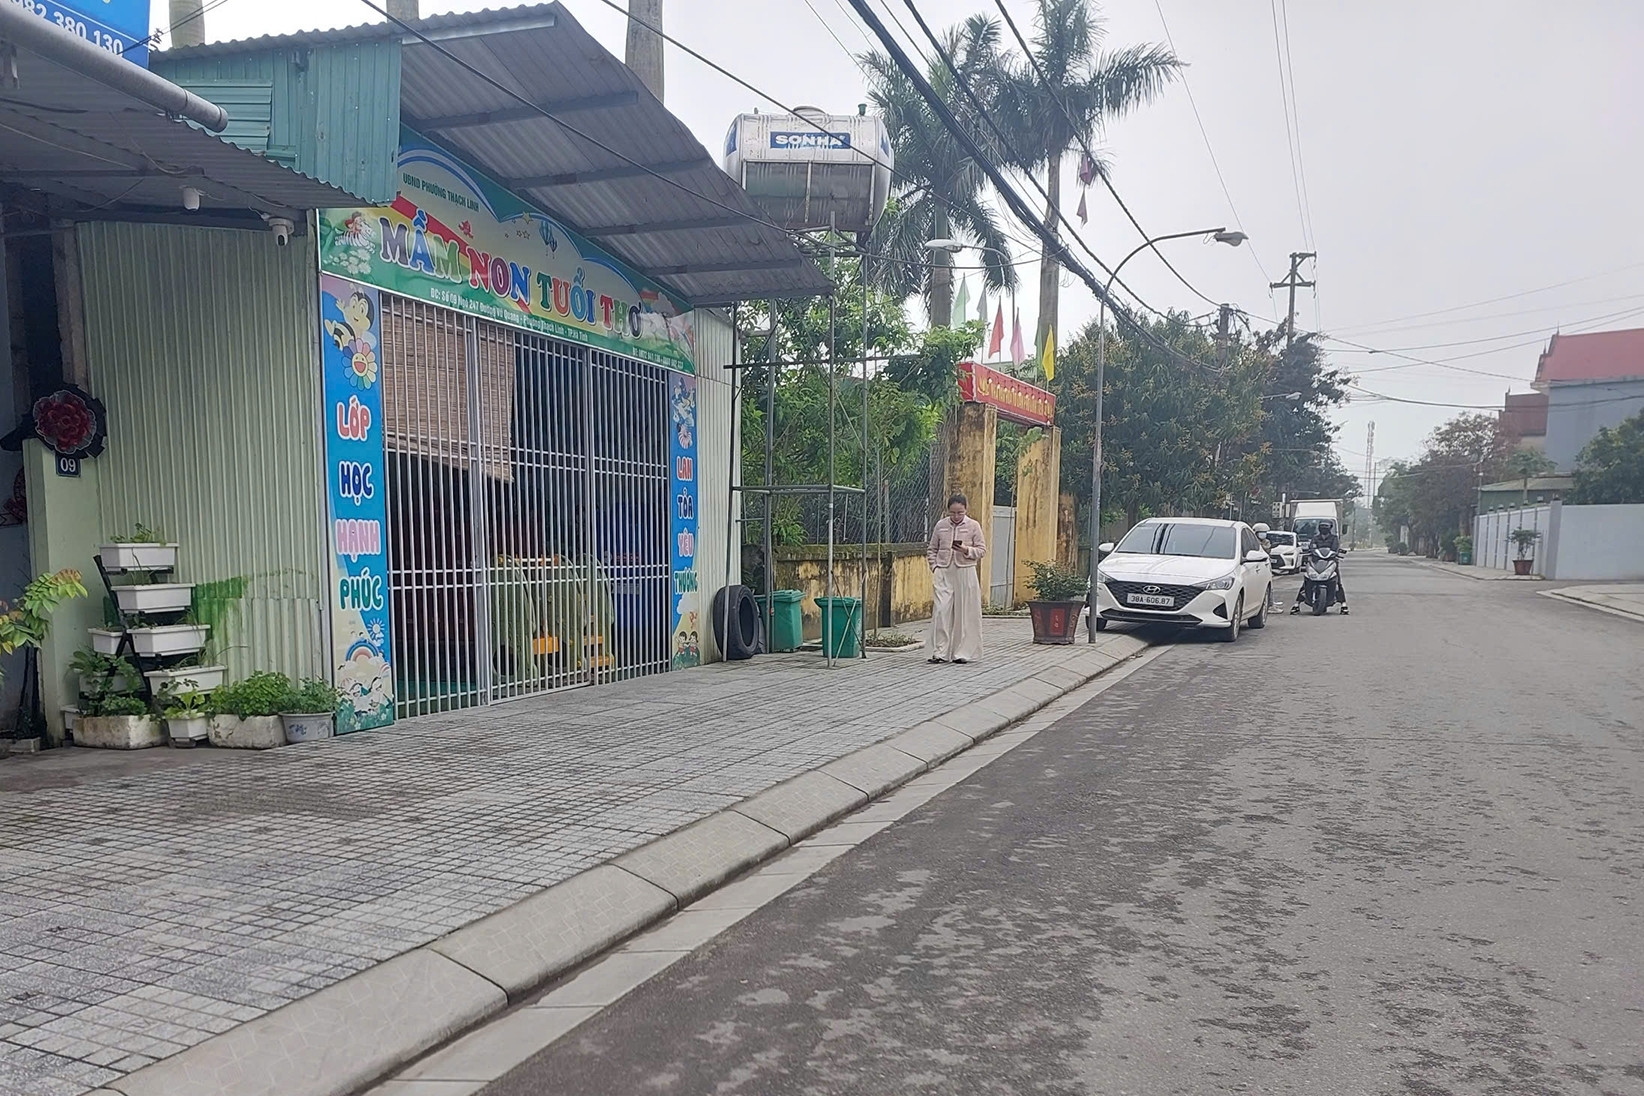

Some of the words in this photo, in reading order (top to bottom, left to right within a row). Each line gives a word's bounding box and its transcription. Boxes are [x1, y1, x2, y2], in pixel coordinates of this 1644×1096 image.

[93, 29, 123, 57] 130
[402, 172, 421, 189] UBND
[421, 180, 447, 199] PHƯỜNG
[447, 190, 467, 206] THẠCH
[466, 199, 479, 212] LINH
[379, 208, 461, 283] MẦM
[466, 246, 531, 305] NON
[536, 266, 596, 326] TUỔI
[600, 294, 642, 340] THƠ
[337, 394, 371, 441] LỚP
[60, 457, 77, 472] 09
[339, 460, 374, 506] HỌC
[676, 456, 693, 481] LAN
[677, 487, 694, 519] TỎA
[335, 518, 381, 562] HẠNH
[677, 527, 694, 557] YÊU
[339, 566, 384, 611] PHÚC
